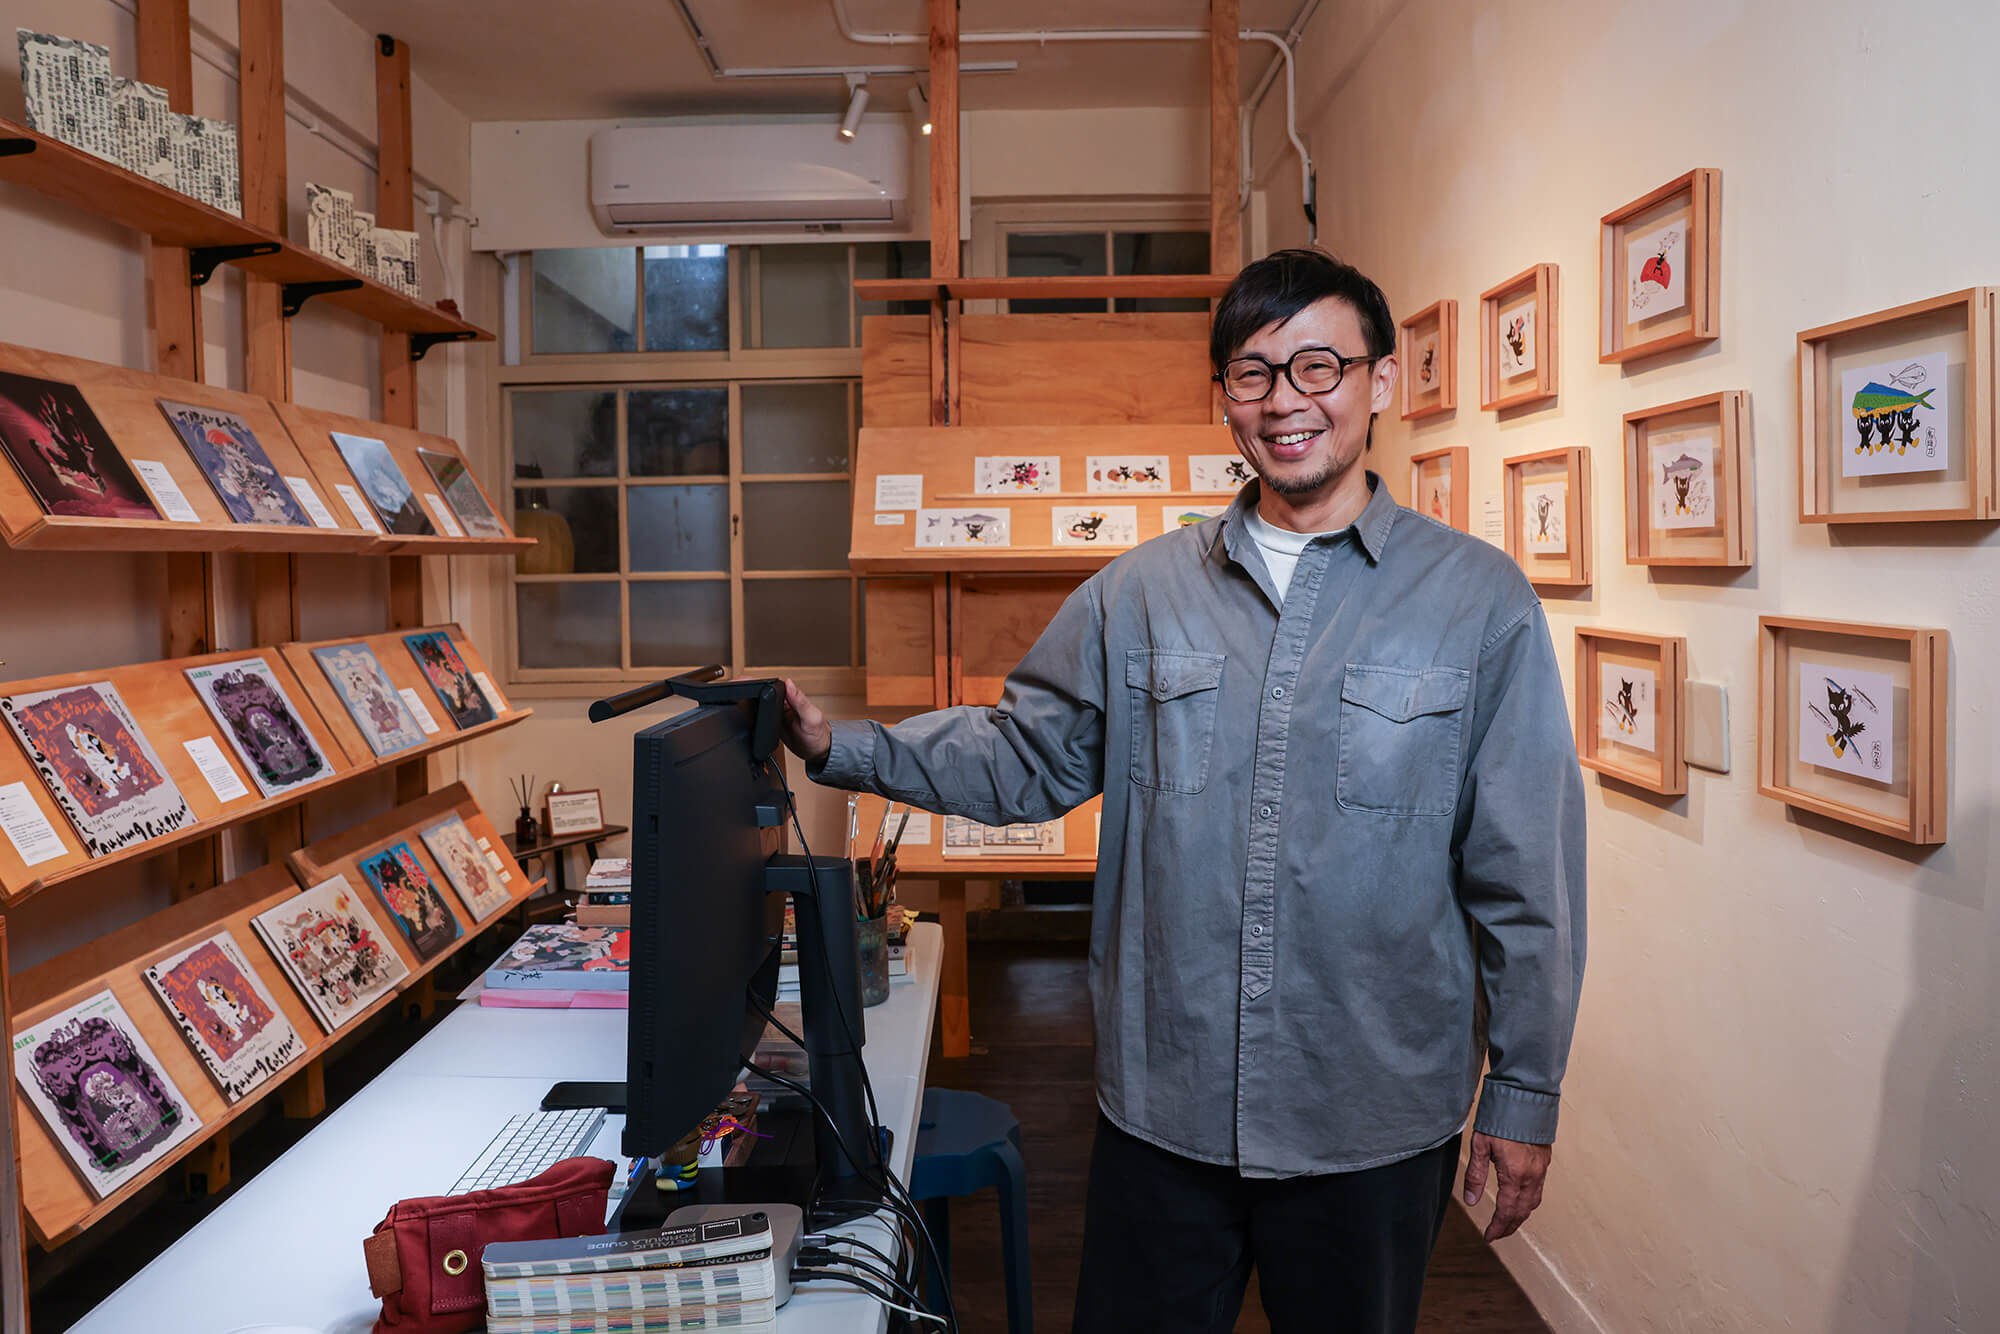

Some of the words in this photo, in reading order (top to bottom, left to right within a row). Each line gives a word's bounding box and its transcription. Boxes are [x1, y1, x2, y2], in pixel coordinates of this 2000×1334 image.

[632, 1232, 697, 1245] FORMULA
[633, 1238, 697, 1249] METALLIC
[587, 1240, 628, 1250] GUIDE
[698, 1252, 767, 1266] PANTONE
